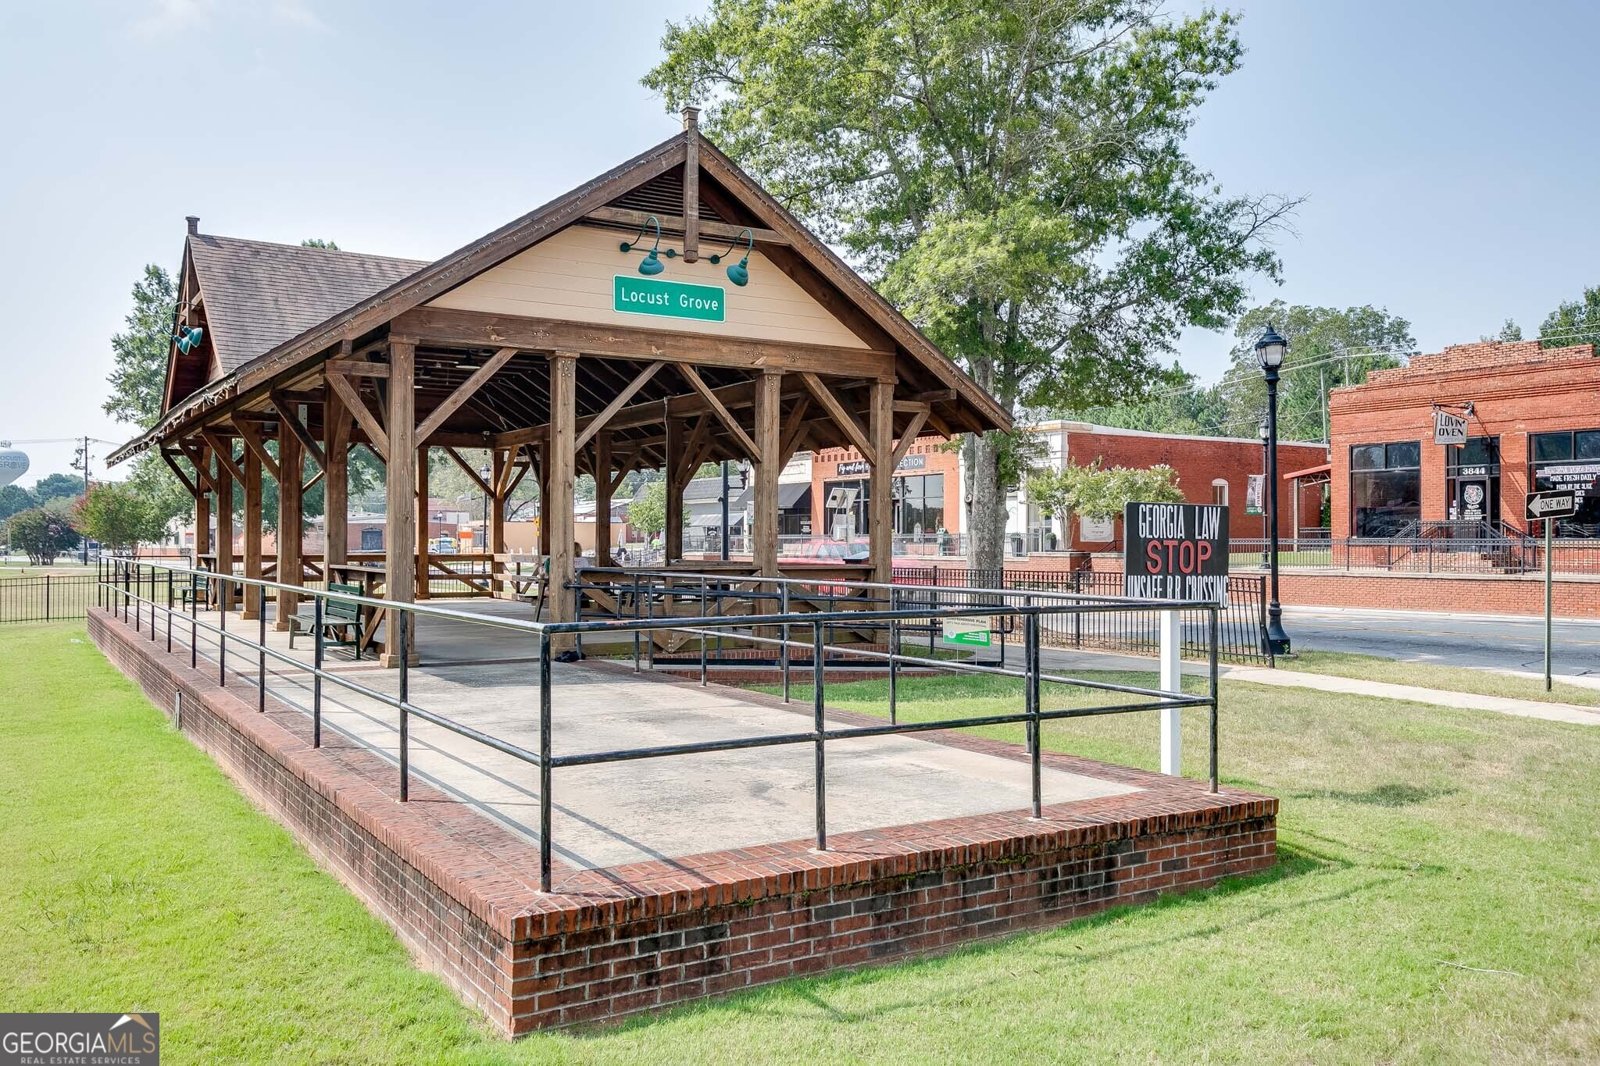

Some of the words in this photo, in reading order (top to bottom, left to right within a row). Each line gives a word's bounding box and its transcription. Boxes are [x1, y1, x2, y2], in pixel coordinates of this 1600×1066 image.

[621, 287, 669, 305] Locust
[679, 294, 719, 311] Grove
[1440, 413, 1465, 427] LOVIN'
[1438, 428, 1464, 436] OVEN
[1462, 467, 1485, 475] 3844
[1580, 473, 1597, 481] DAILY
[1540, 499, 1554, 510] ONE
[1556, 498, 1570, 508] WAY
[1139, 504, 1185, 539] GEORGIA
[1195, 505, 1221, 540] LAW
[1146, 539, 1212, 574] STOP
[1186, 575, 1229, 608] CROSSING
